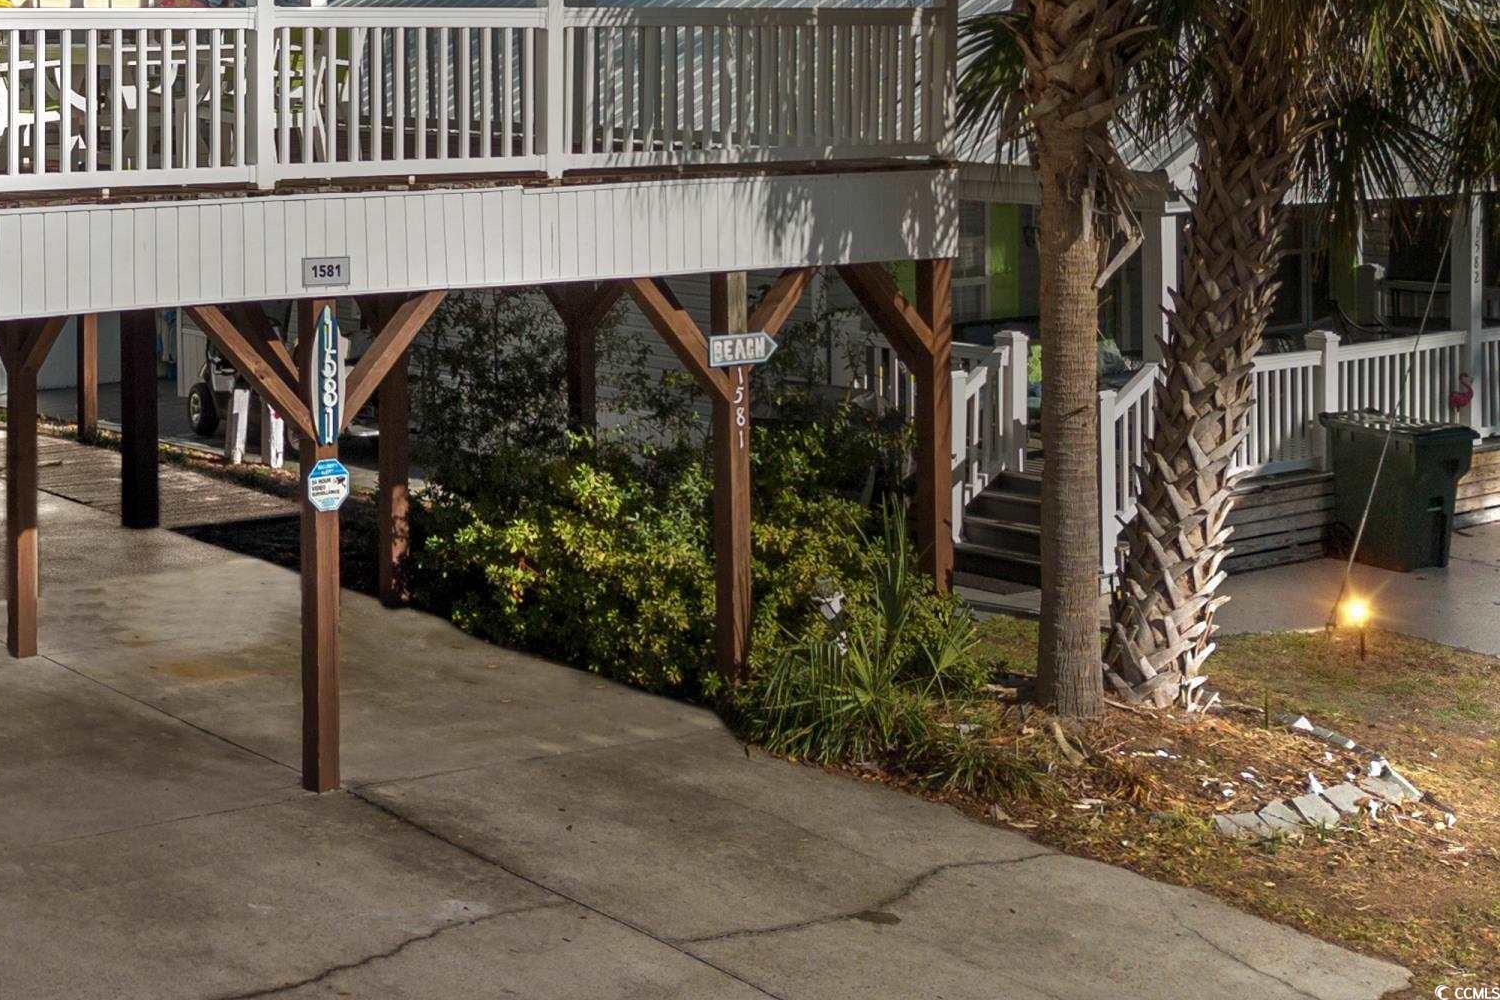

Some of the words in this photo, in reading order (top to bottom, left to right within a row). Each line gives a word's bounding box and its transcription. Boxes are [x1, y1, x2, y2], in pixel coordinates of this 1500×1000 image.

[311, 264, 342, 278] 1581
[713, 336, 766, 362] BEACH
[322, 315, 338, 444] 1581
[733, 367, 746, 449] 1581
